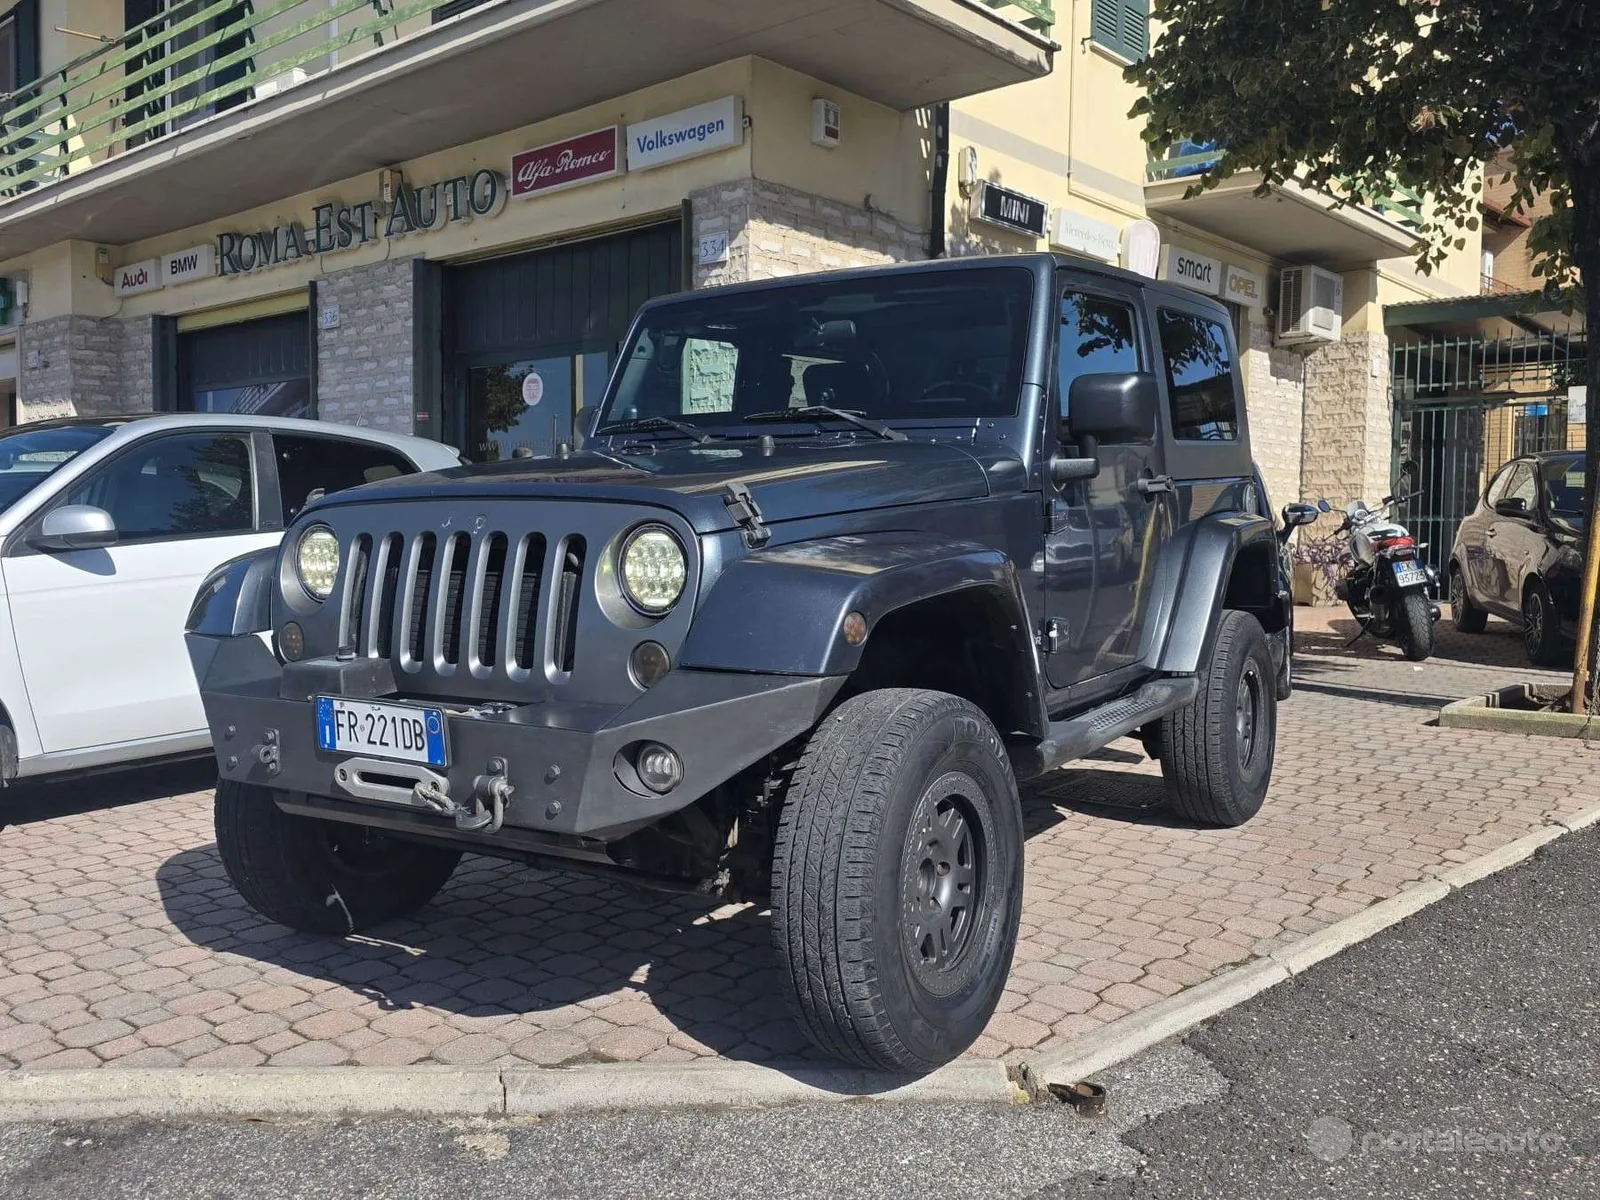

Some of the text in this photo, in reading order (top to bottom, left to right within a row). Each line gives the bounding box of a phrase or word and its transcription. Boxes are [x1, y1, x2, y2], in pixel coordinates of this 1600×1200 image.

[636, 118, 725, 154] Volkswagen
[517, 149, 612, 189] Alfa Romeo
[216, 169, 499, 277] ROMA EST AUTO
[1000, 195, 1030, 224] MINI
[121, 268, 148, 289] Audi
[170, 254, 198, 275] BMW
[1177, 256, 1212, 283] smart
[1229, 273, 1258, 299] OPEL
[335, 709, 360, 743] FR
[365, 713, 426, 752] 221DB
